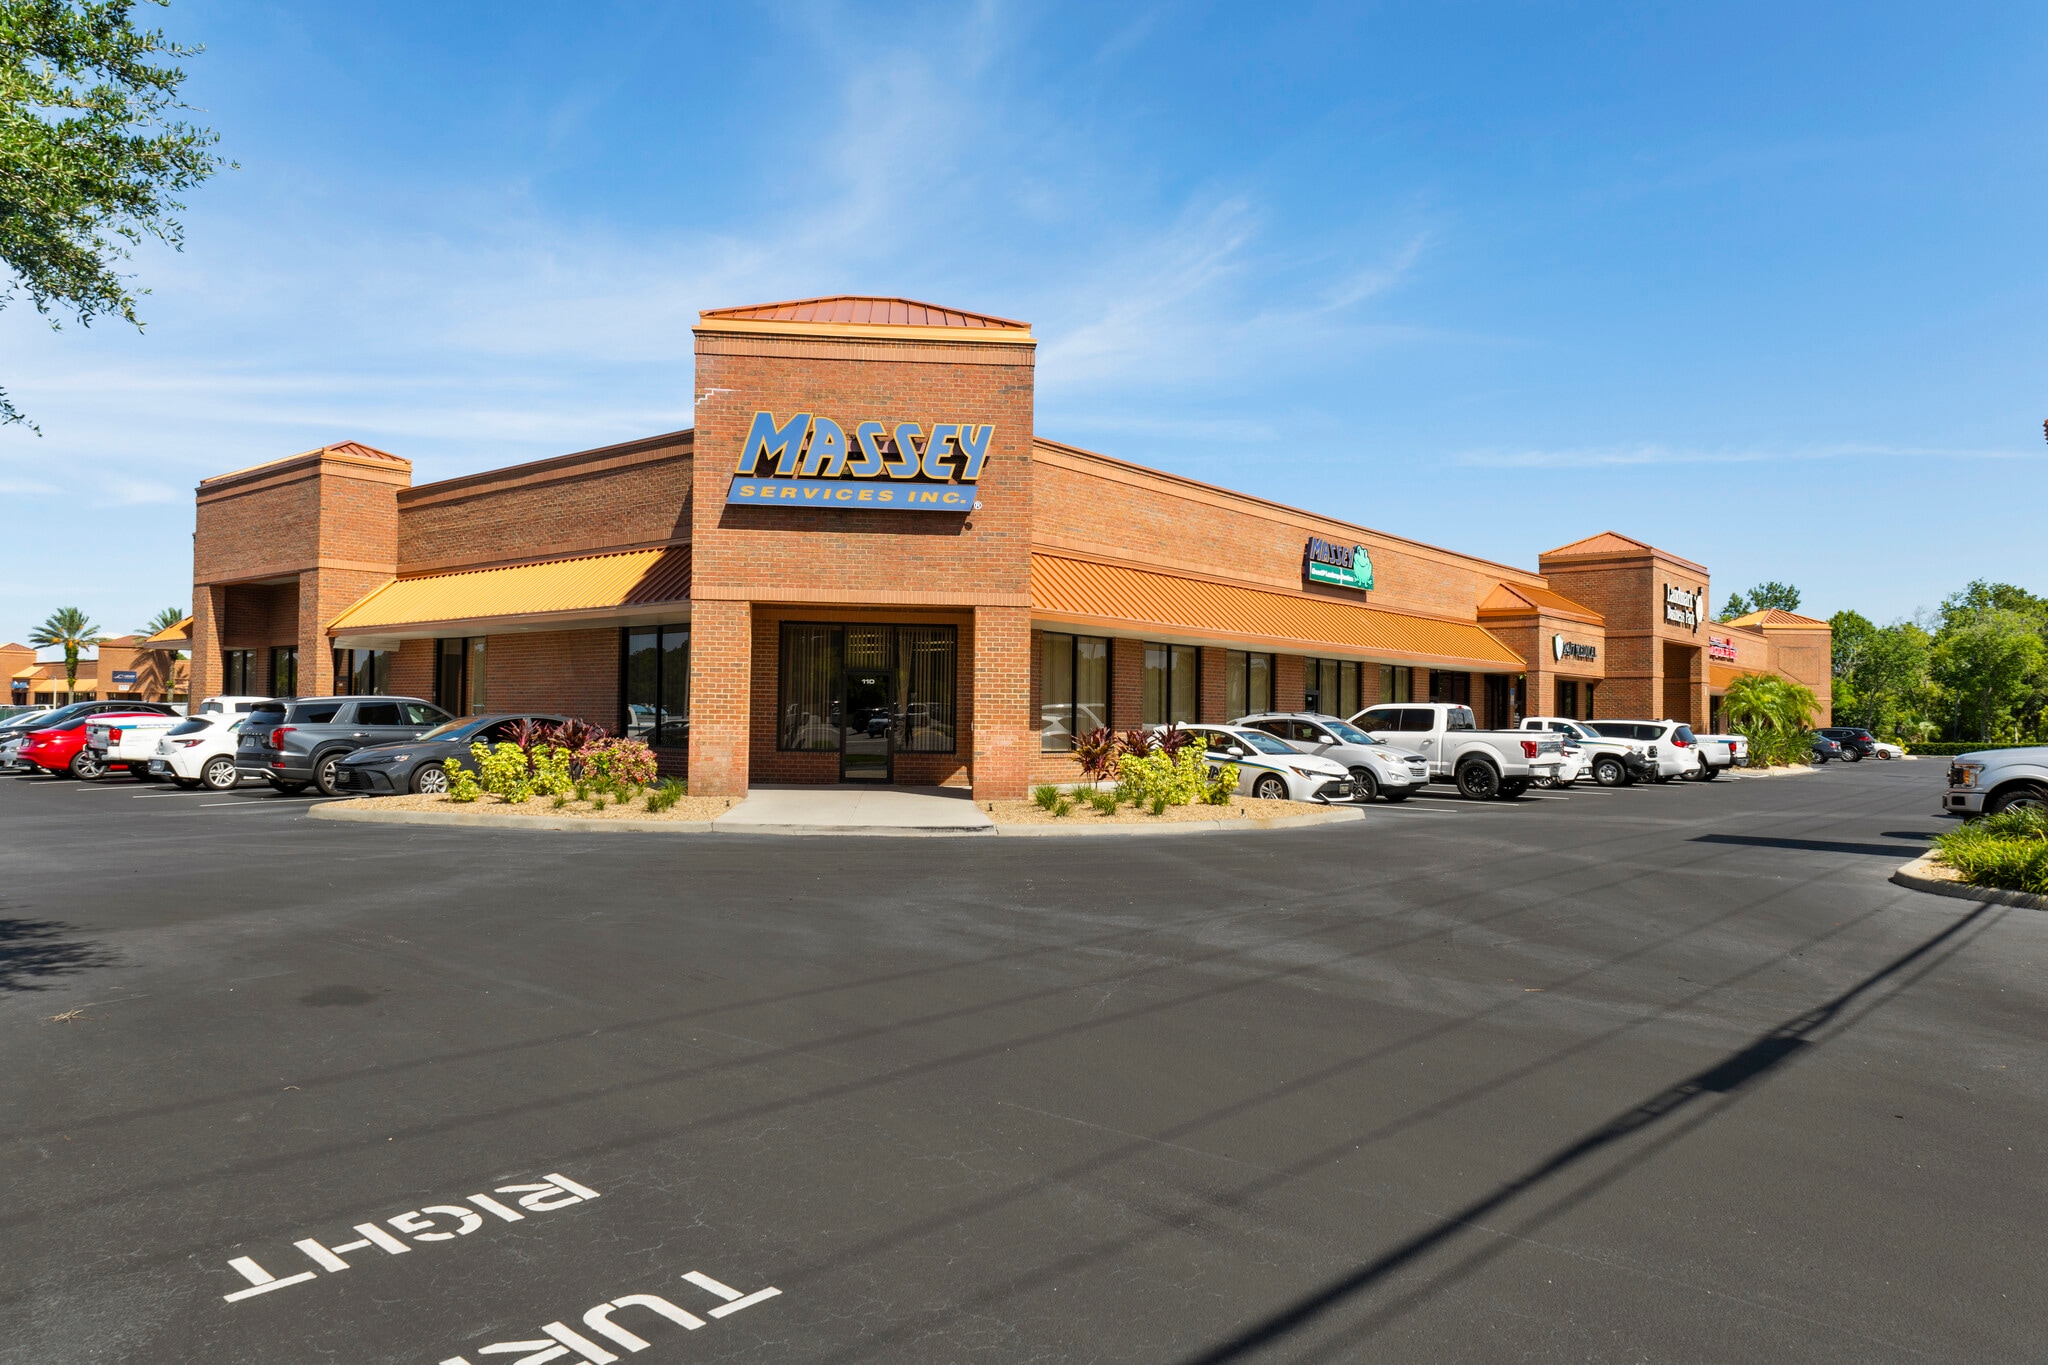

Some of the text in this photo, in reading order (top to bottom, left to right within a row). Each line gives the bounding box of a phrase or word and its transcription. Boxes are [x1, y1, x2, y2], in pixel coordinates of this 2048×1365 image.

[735, 410, 996, 480] MASSEY
[739, 484, 894, 502] SERVICES
[907, 490, 967, 504] INC.
[1310, 537, 1355, 568] MASSEY
[223, 1173, 600, 1303] RIGHT
[438, 1270, 783, 1365] TUR
